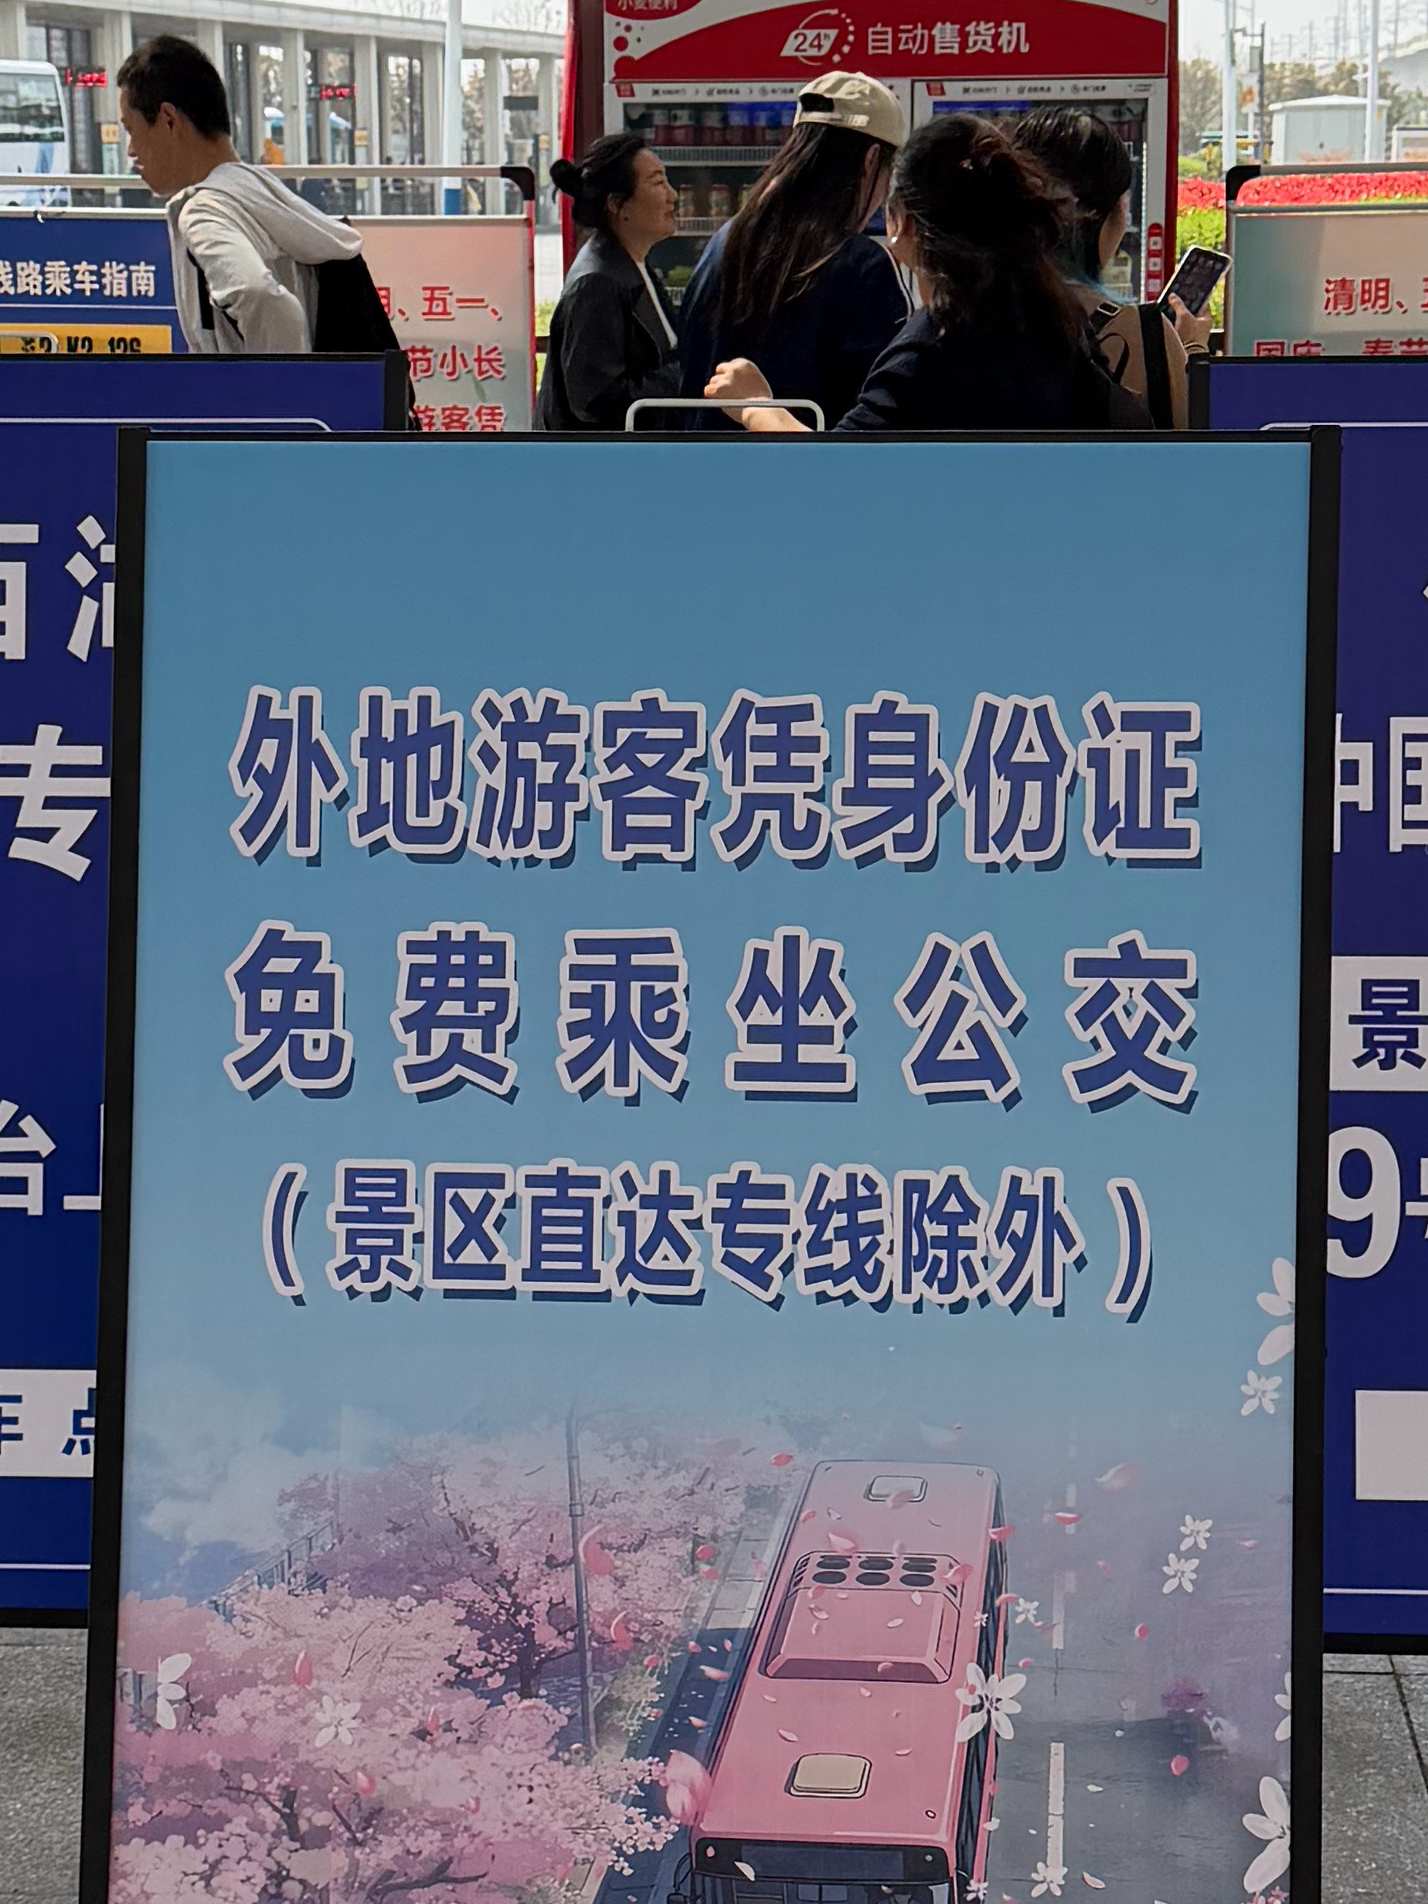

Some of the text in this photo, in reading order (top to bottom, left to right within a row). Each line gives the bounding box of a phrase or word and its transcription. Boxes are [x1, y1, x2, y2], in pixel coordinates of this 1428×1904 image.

[868, 21, 1029, 55] 自动售货机
[228, 686, 1203, 868] 外地游客凭身份证
[225, 921, 1197, 1113] 免费乘坐公交
